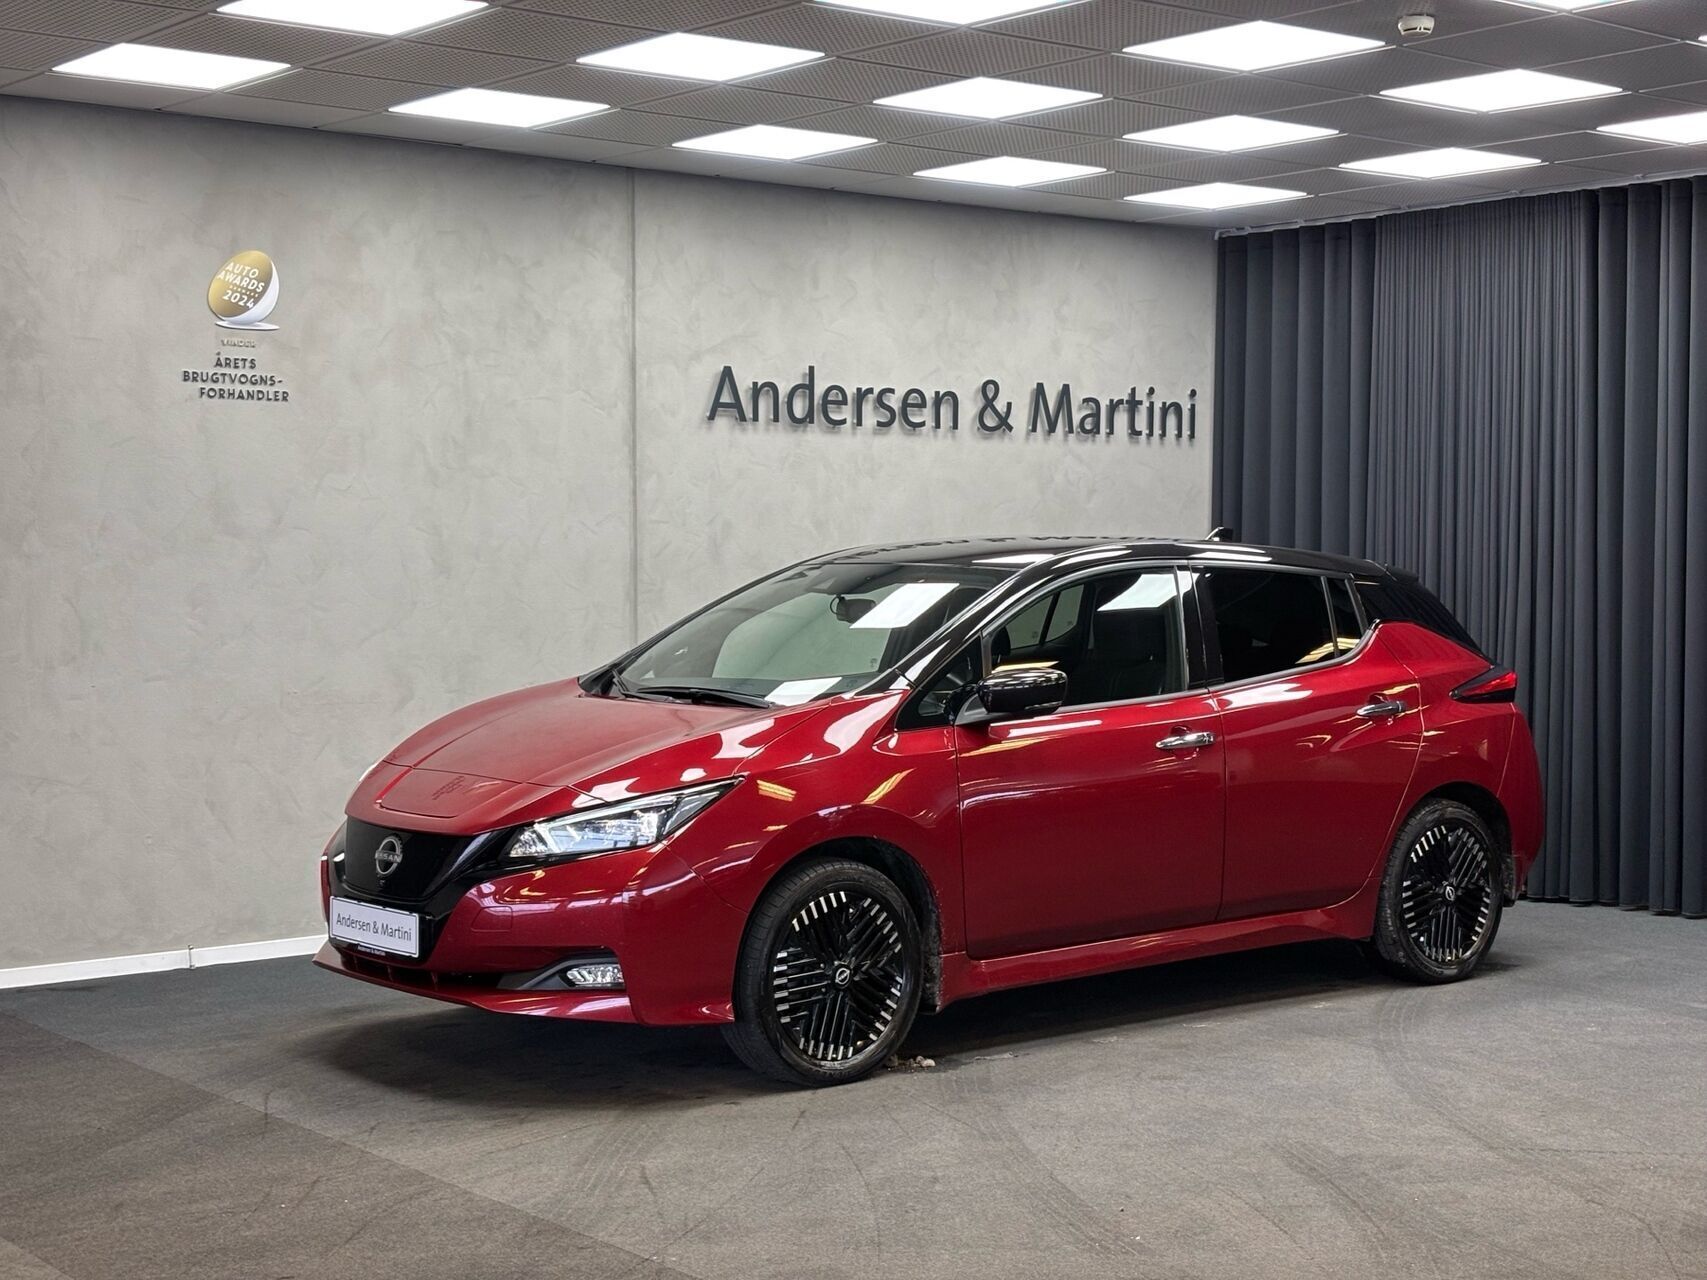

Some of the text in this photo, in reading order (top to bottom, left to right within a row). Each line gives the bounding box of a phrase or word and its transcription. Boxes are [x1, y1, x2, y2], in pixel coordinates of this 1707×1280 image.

[225, 262, 259, 278] AUTO
[217, 270, 265, 293] AWARDS
[222, 289, 255, 309] 2024
[214, 352, 257, 369] ÅRETS
[183, 370, 283, 386] BRUGTVOGNS-
[199, 387, 289, 402] FORHANDLER
[707, 365, 1198, 440] Andersen & Martini
[336, 913, 412, 942] Andersen & Martini
